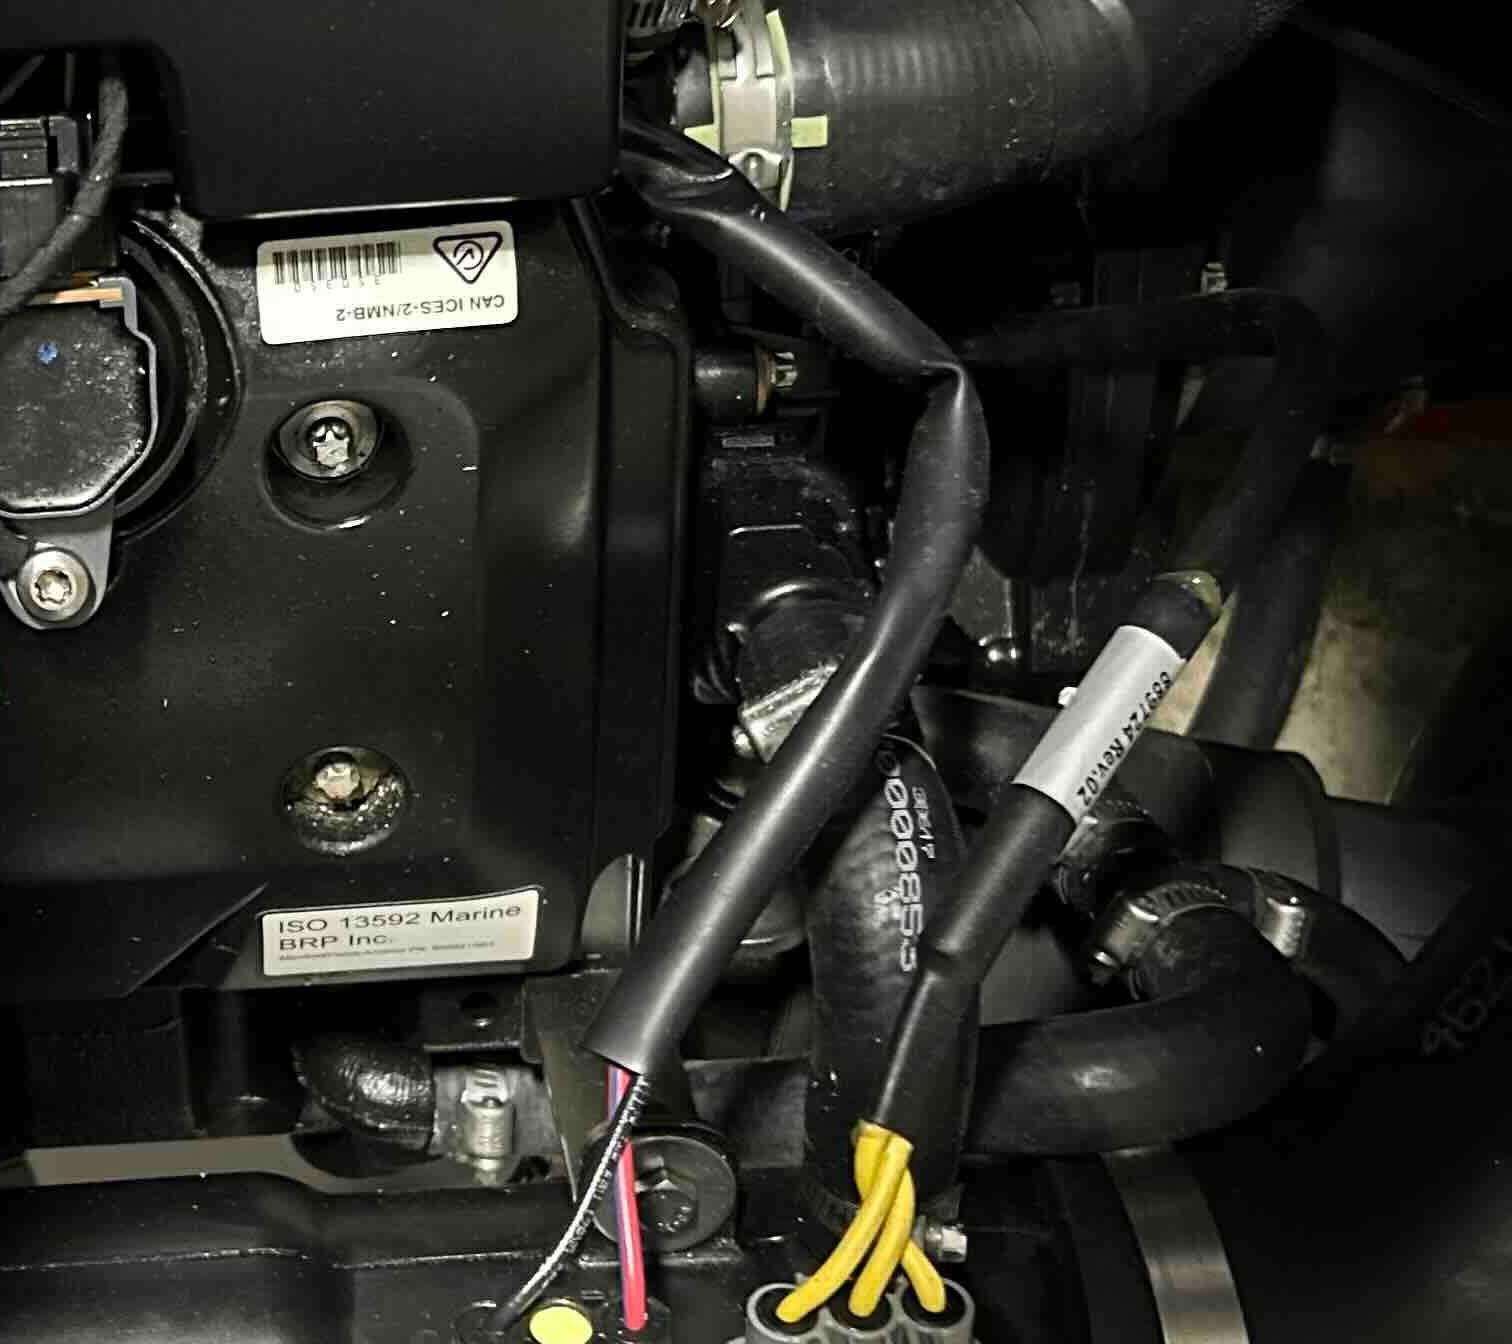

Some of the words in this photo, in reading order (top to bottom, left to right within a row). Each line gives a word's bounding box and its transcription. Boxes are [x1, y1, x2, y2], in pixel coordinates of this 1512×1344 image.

[336, 299, 464, 322] ICES-2/NMB-2
[470, 294, 505, 310] CAN
[279, 918, 328, 934] ISO
[339, 911, 421, 931] 13592
[430, 904, 522, 924] Marine
[279, 934, 338, 952] BRP
[348, 933, 394, 947] Inc.
